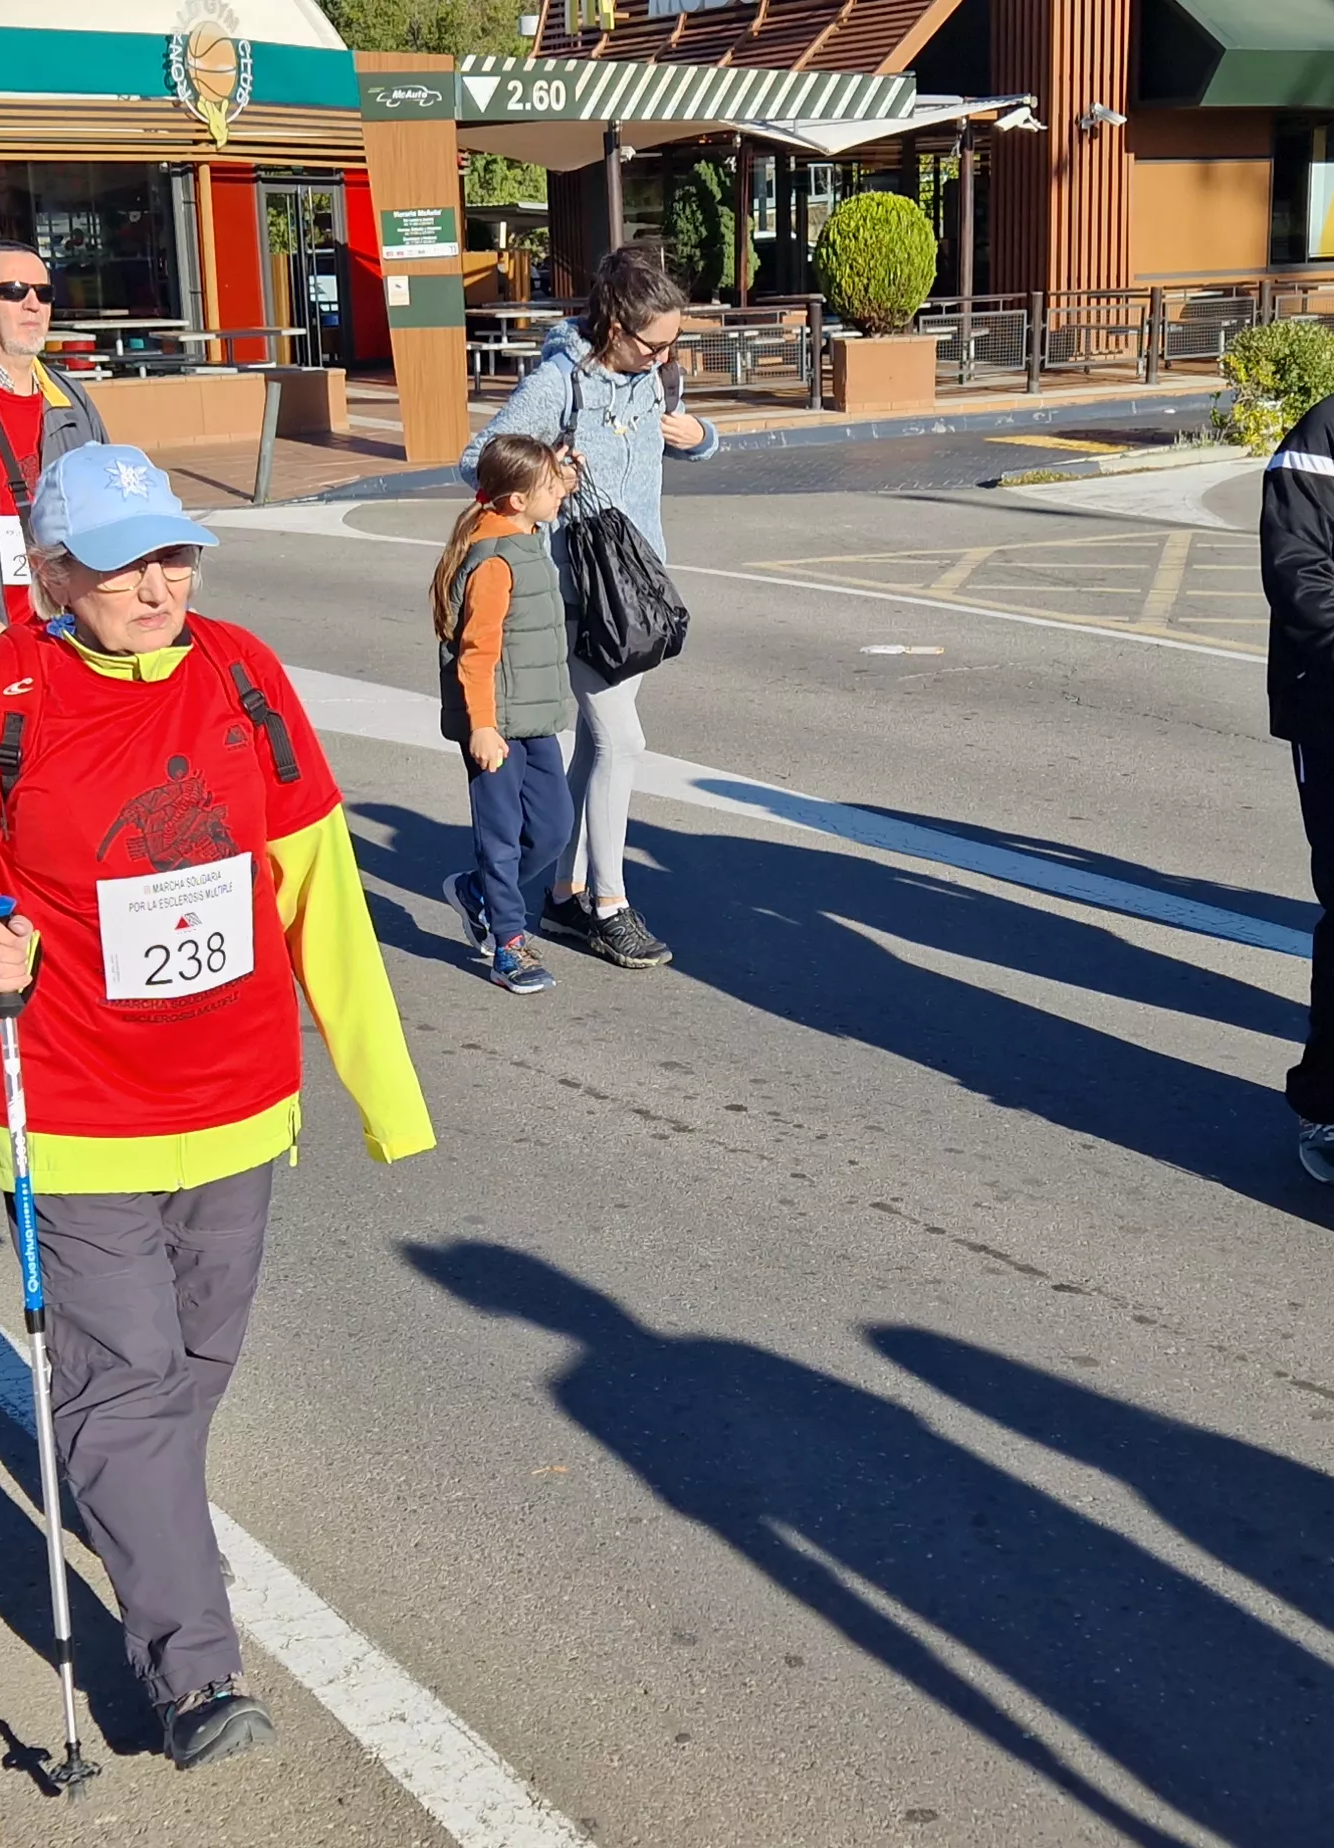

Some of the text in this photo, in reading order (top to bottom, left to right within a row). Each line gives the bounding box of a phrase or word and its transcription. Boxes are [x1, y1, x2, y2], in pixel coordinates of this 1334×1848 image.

[236, 40, 253, 107] CLUB
[392, 89, 428, 99] McAuto
[507, 80, 566, 111] 2.60
[152, 880, 185, 894] MARCHA
[186, 871, 222, 888] SOLIDARIA
[129, 901, 145, 912] POR
[147, 899, 157, 911] LA
[159, 890, 204, 909] ESCLEROSIS
[144, 931, 226, 986] 238
[25, 1229, 39, 1293] Quechua
